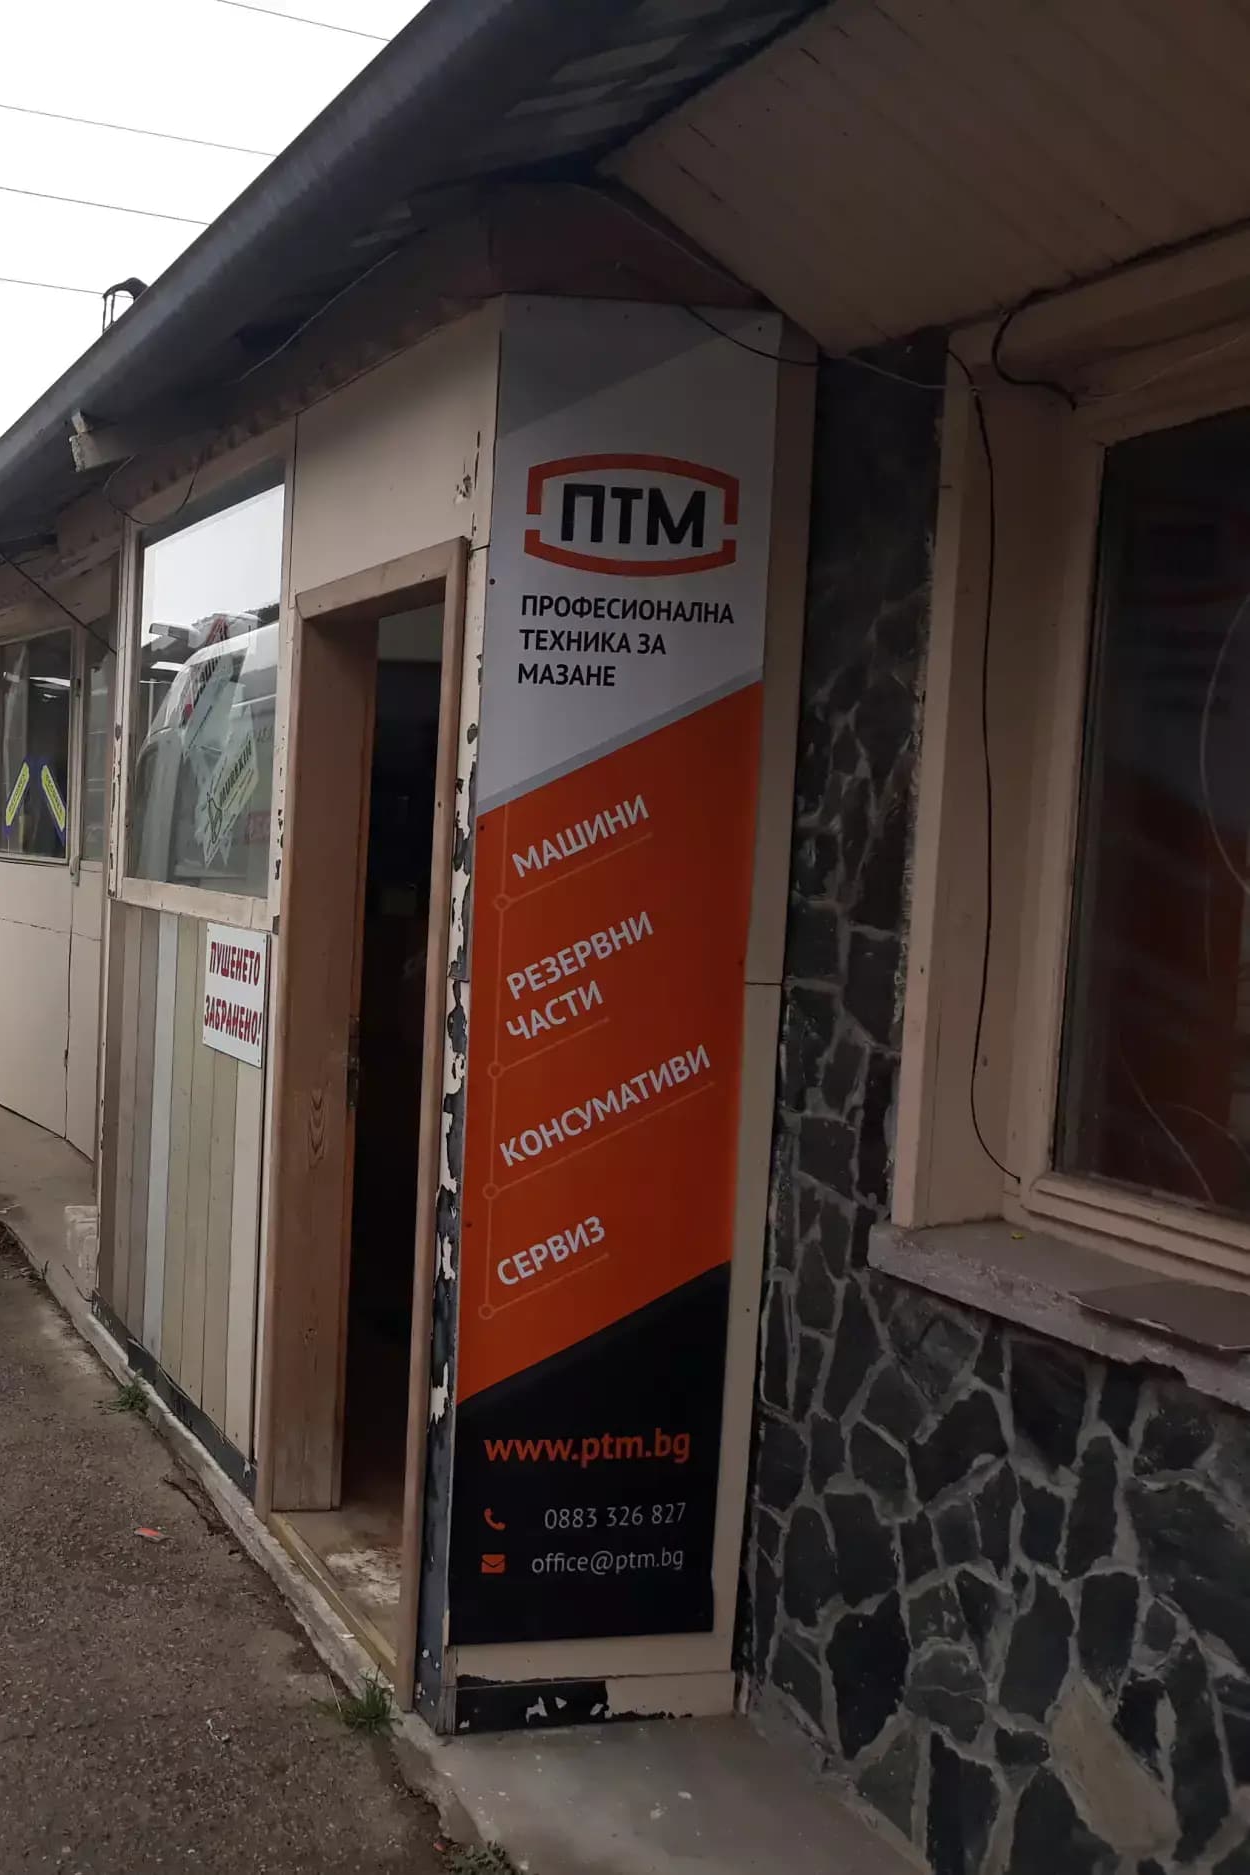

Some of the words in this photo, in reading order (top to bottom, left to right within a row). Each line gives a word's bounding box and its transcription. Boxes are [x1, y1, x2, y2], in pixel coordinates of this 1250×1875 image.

[560, 483, 706, 548] ПТМ
[520, 594, 735, 625] ПРОФЕСИОНАЛНА
[519, 628, 632, 655] ТЕХНИКА
[637, 632, 667, 656] ЗА
[517, 662, 617, 688] МАЗАНЕ
[511, 794, 650, 878] МАШИНИ
[209, 941, 261, 987] ПУШЕНЕТО
[506, 911, 655, 1001] РЕЗЕРВНИ
[204, 994, 263, 1047] ЗАБРАНЕНО!
[505, 980, 604, 1042] ЧАСТИ
[499, 1044, 712, 1168] КОНСУМАТИВИ
[496, 1215, 607, 1287] СЕРВИЗ
[483, 1427, 692, 1469] www.ptm.bg
[544, 1507, 598, 1530] 0883
[606, 1505, 644, 1528] 326
[651, 1502, 687, 1526] 827
[531, 1547, 684, 1576] office@ptm.bg
